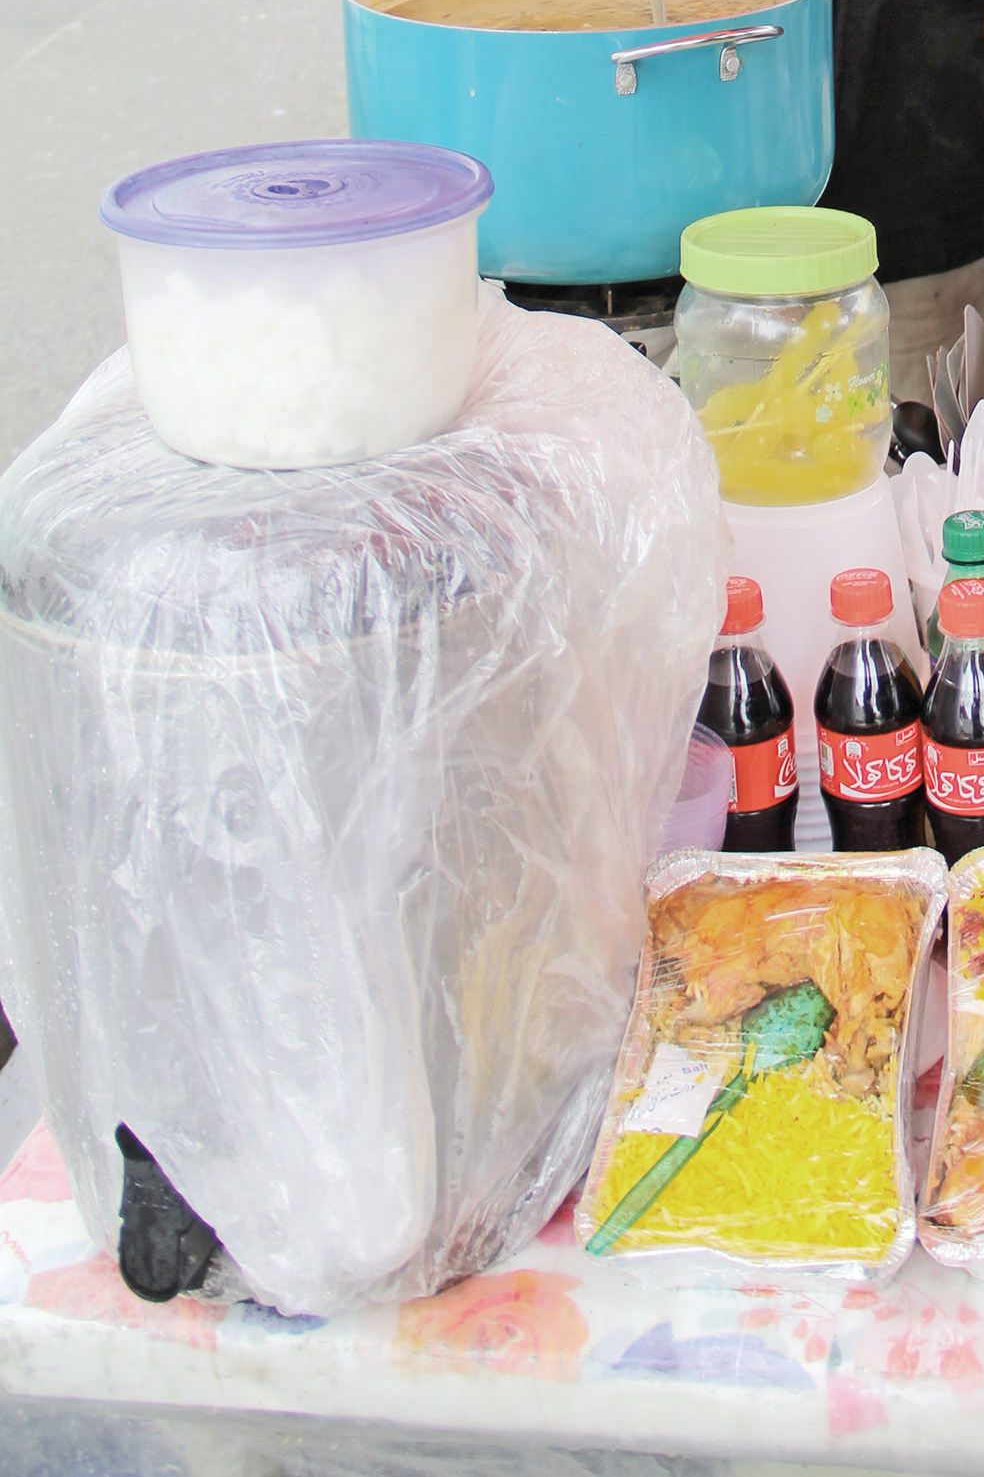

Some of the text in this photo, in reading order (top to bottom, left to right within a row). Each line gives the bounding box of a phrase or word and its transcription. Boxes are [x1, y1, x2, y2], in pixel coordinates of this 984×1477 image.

[848, 372, 876, 391] Flower
[899, 726, 916, 743] اصل
[842, 757, 883, 790] کولا
[884, 746, 917, 784] کوکا
[682, 1064, 708, 1074] Salt
